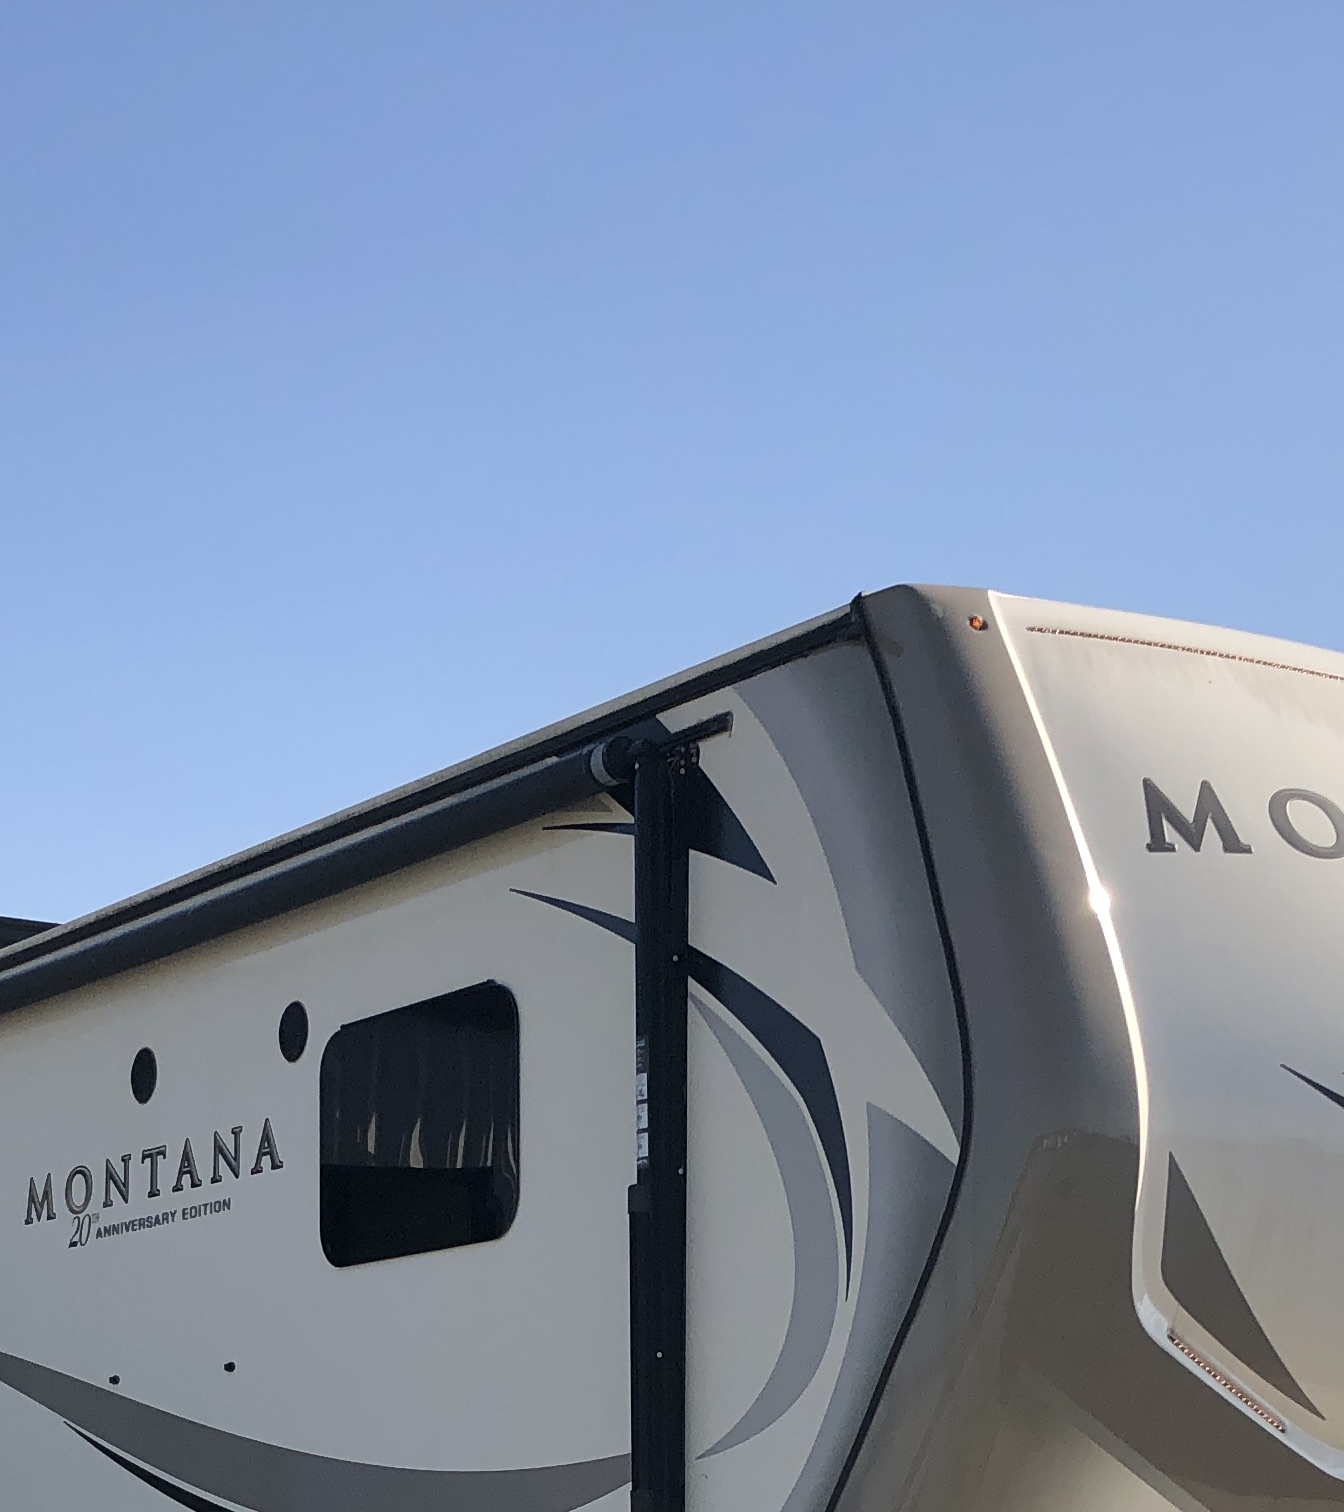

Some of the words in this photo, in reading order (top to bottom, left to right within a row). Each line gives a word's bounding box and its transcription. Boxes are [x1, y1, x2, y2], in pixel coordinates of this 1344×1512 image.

[24, 1116, 284, 1225] MONTANA
[95, 1209, 178, 1240] ANNIVERSARY
[181, 1197, 232, 1221] EDITION
